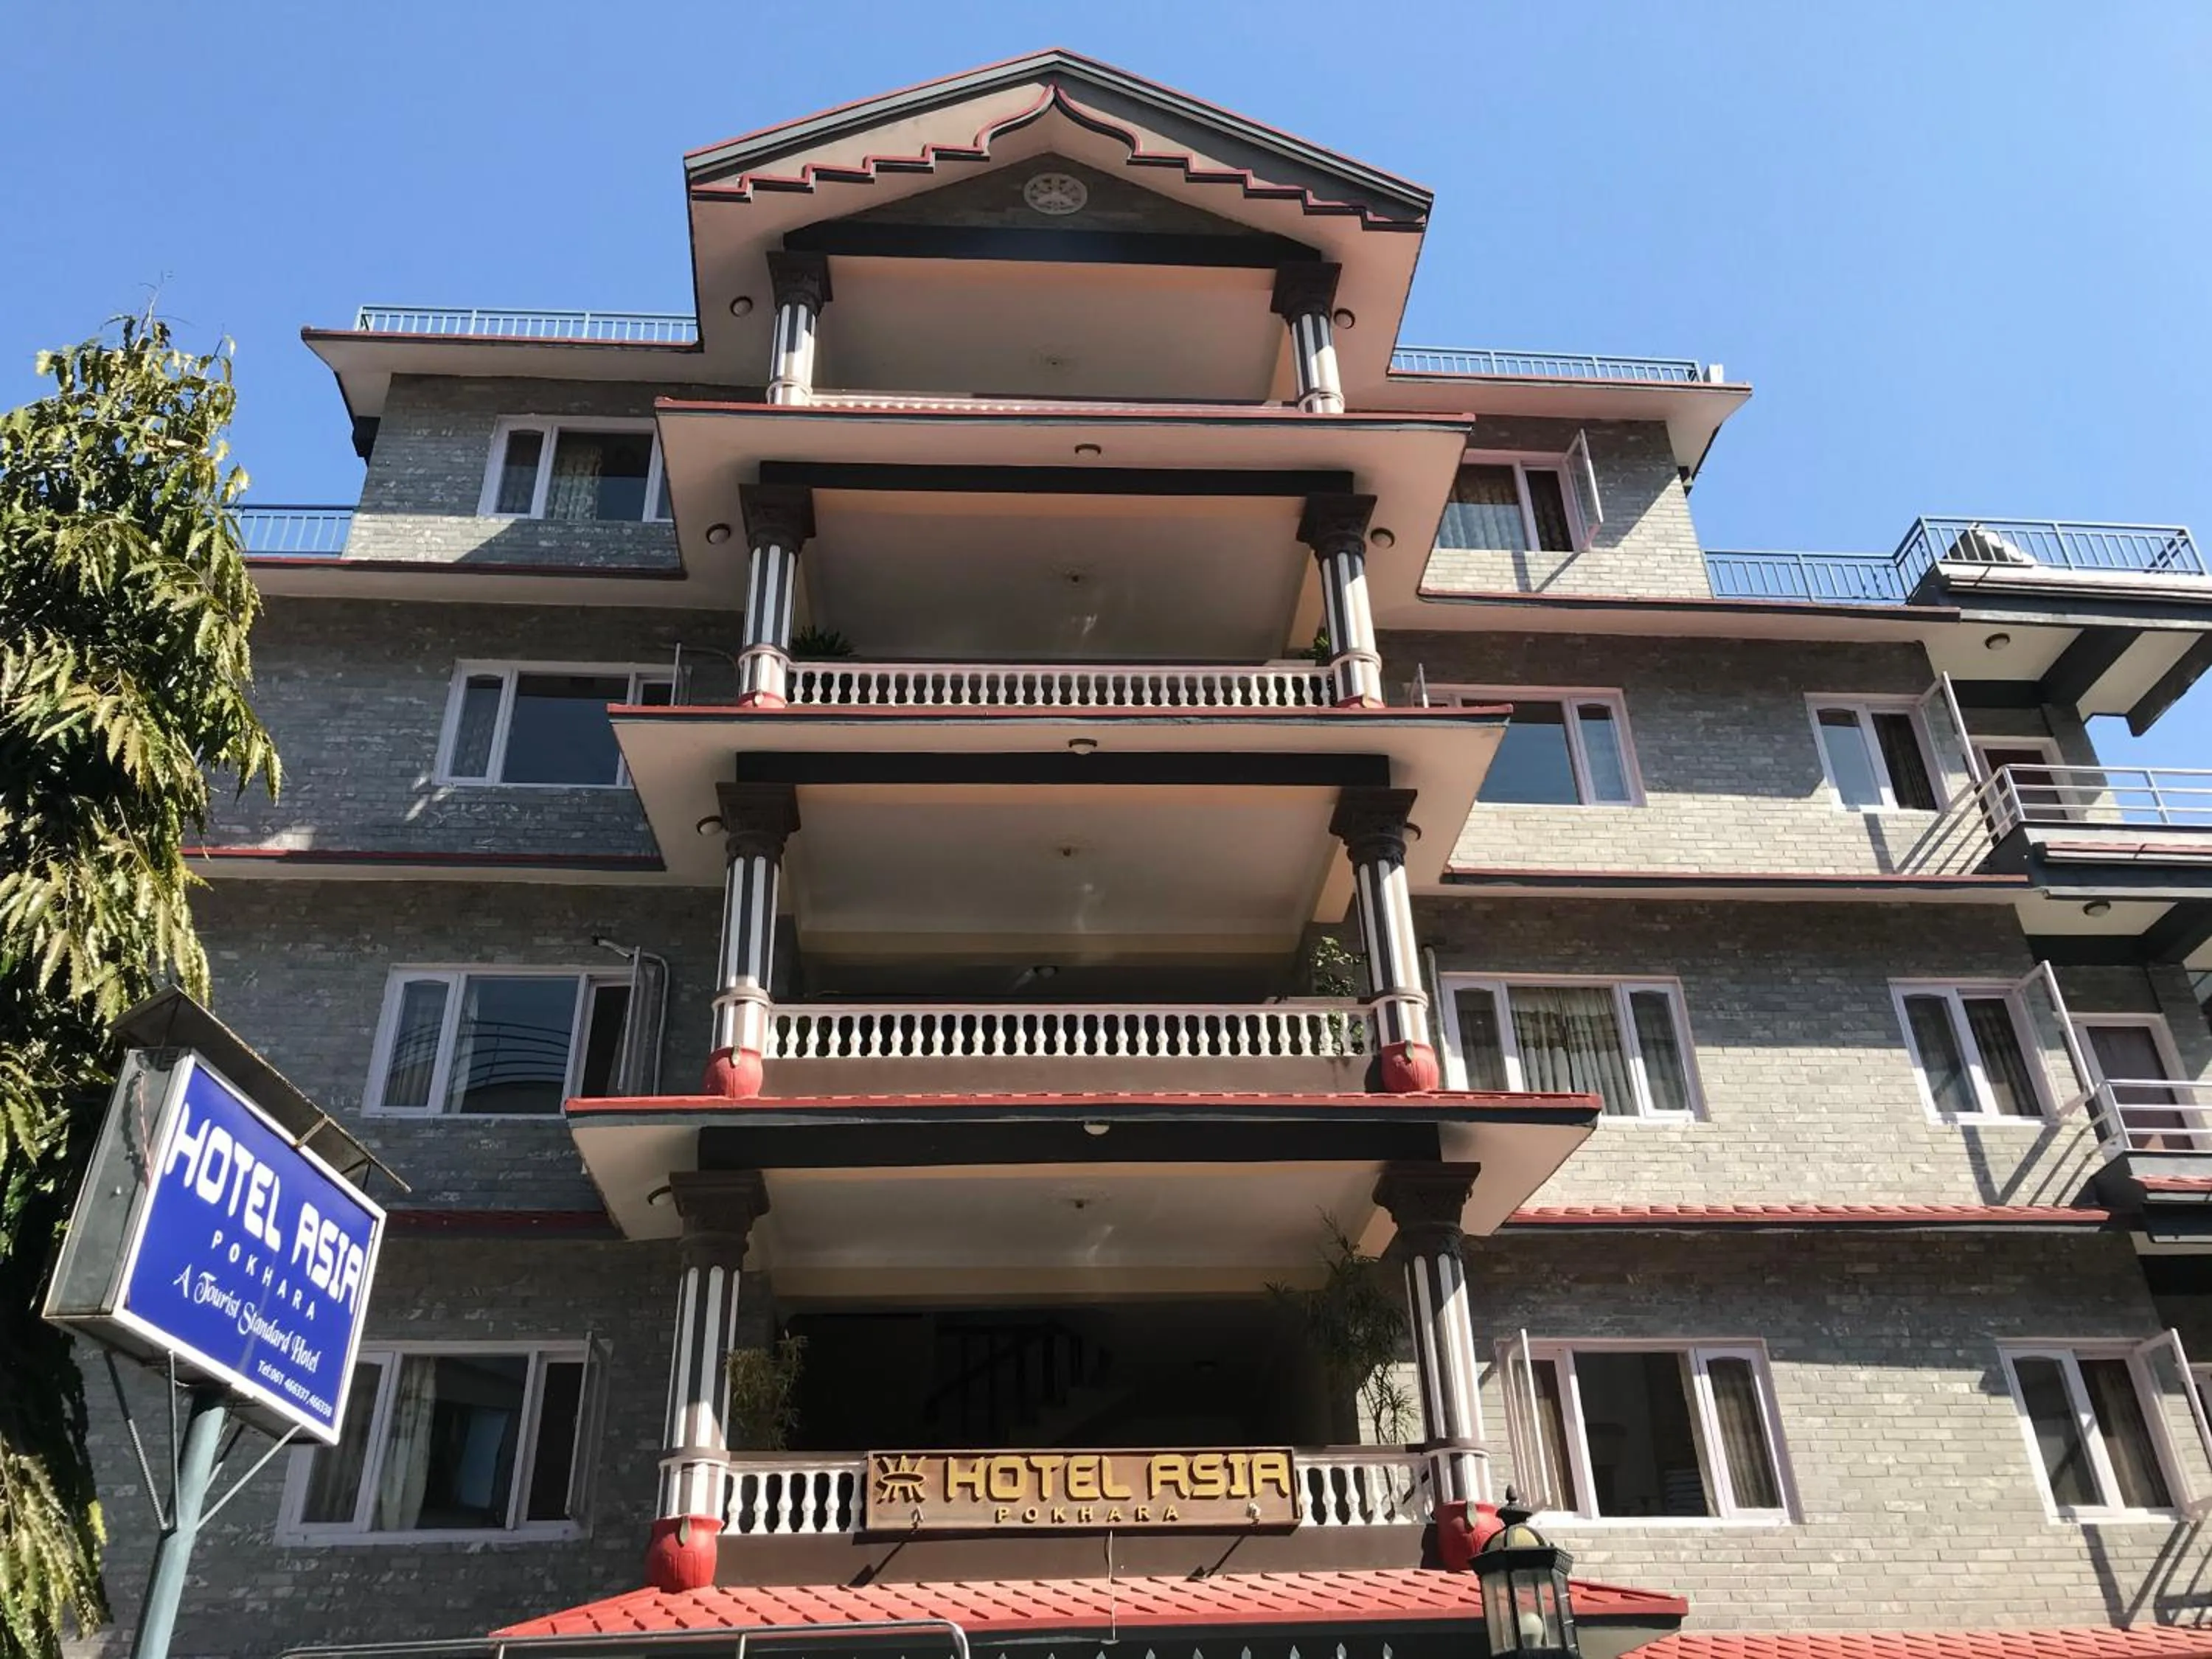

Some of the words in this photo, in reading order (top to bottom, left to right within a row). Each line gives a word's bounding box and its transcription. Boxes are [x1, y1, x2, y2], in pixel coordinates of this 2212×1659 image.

[166, 1102, 281, 1252] HOTEL
[291, 1203, 364, 1315] ASIA
[173, 1263, 192, 1298] A
[194, 1271, 241, 1318] Tourist
[237, 1301, 293, 1354] Standard
[291, 1335, 321, 1373] Hotel
[211, 1230, 315, 1320] POKHARA
[945, 1455, 1131, 1501] HOTEL
[1148, 1453, 1290, 1500] ASIA
[995, 1506, 1180, 1523] POKHARA
